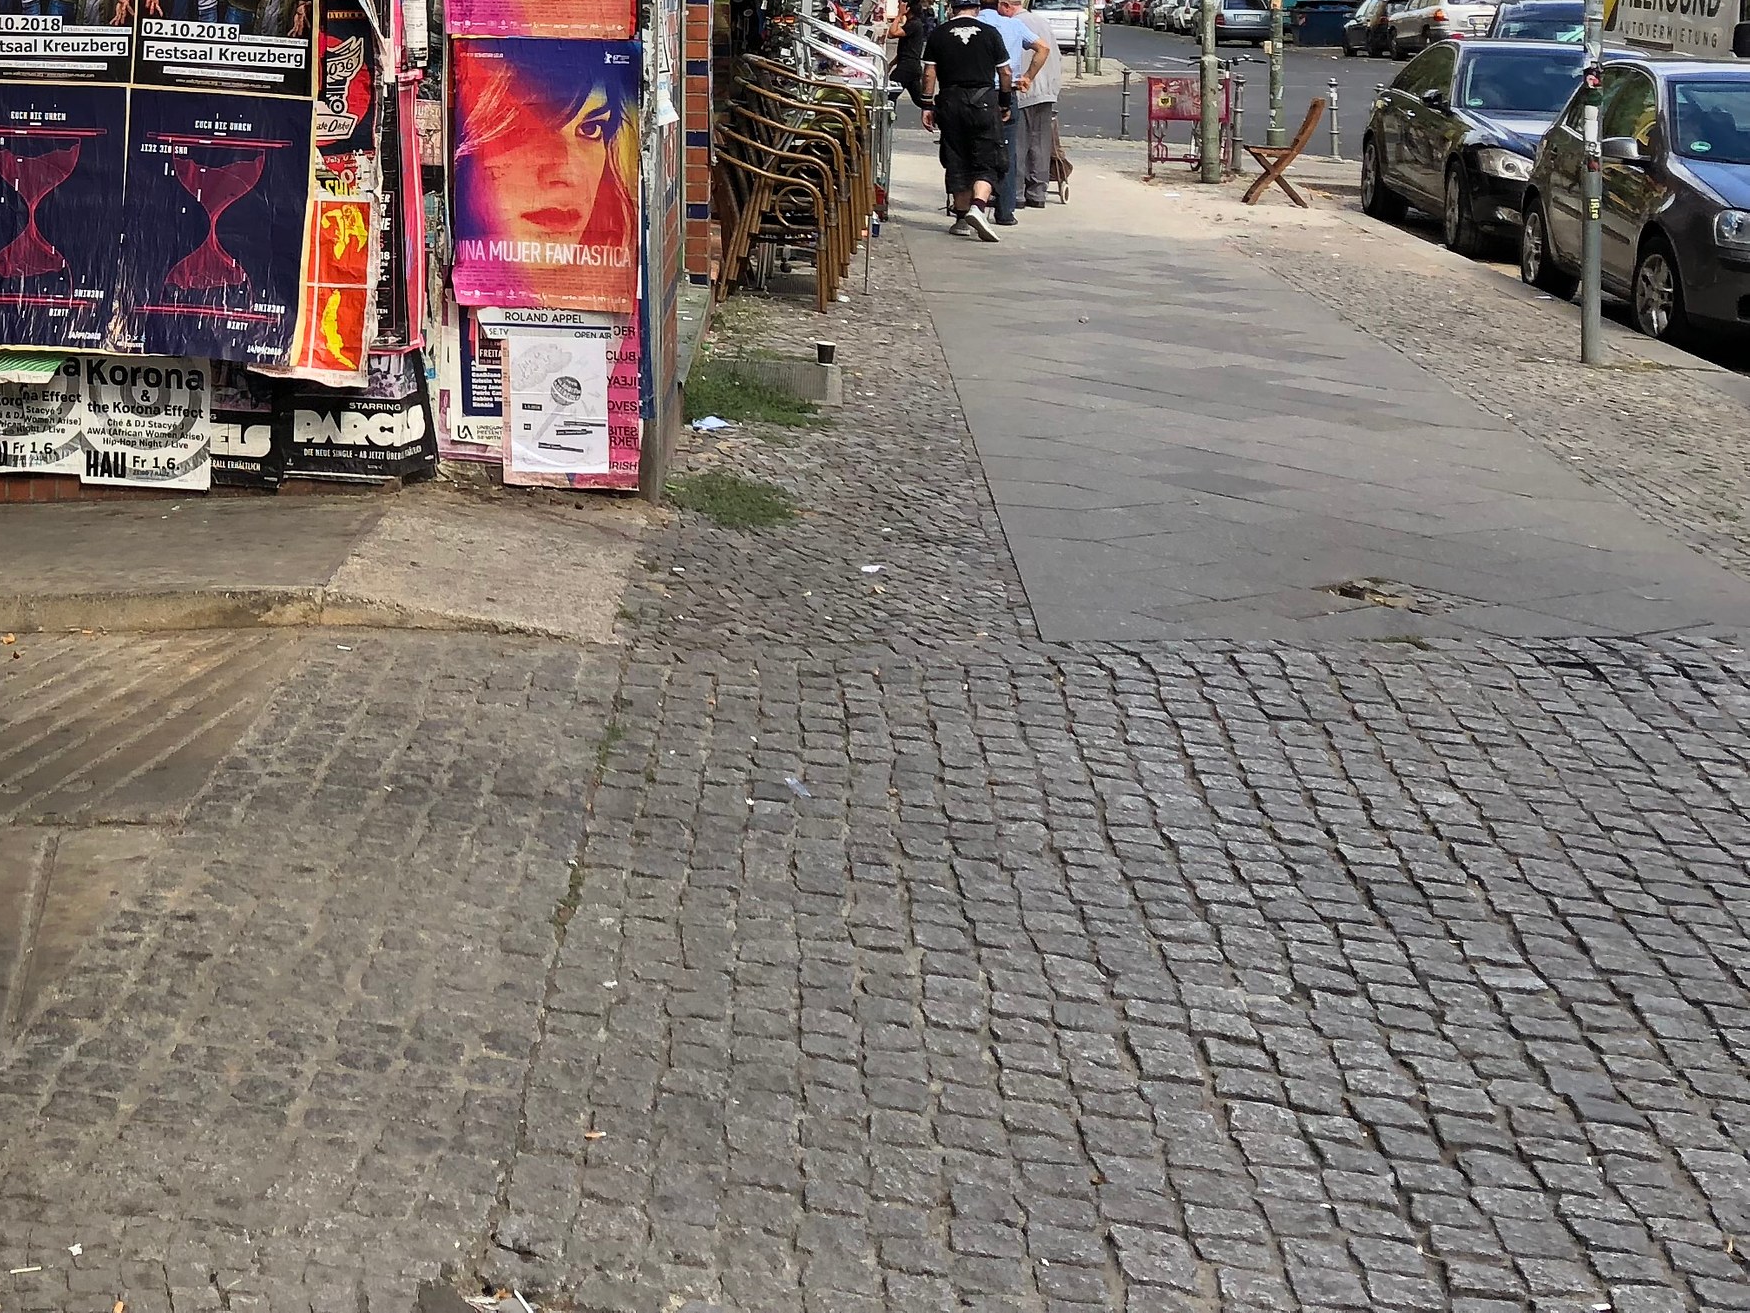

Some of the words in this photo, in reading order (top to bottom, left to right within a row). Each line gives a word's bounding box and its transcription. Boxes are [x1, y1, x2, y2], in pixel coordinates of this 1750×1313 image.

[1618, 20, 1718, 48] AUTOVERMIETUNG
[43, 38, 126, 55] Kreuzberg
[505, 312, 548, 322] ROLAND
[552, 313, 584, 323] APPEL
[87, 358, 204, 391] Korona
[87, 402, 109, 414] the
[112, 403, 161, 416] Korona
[164, 405, 203, 419] Effect
[349, 402, 401, 411] STARRING
[87, 427, 106, 435] AWA
[145, 429, 178, 439] Women
[315, 449, 331, 457] NEUE
[332, 449, 353, 459] SINGLE
[368, 451, 385, 460] JETZT
[86, 450, 126, 478] HAU
[132, 457, 147, 469] Fr
[152, 457, 180, 471] 1.6.
